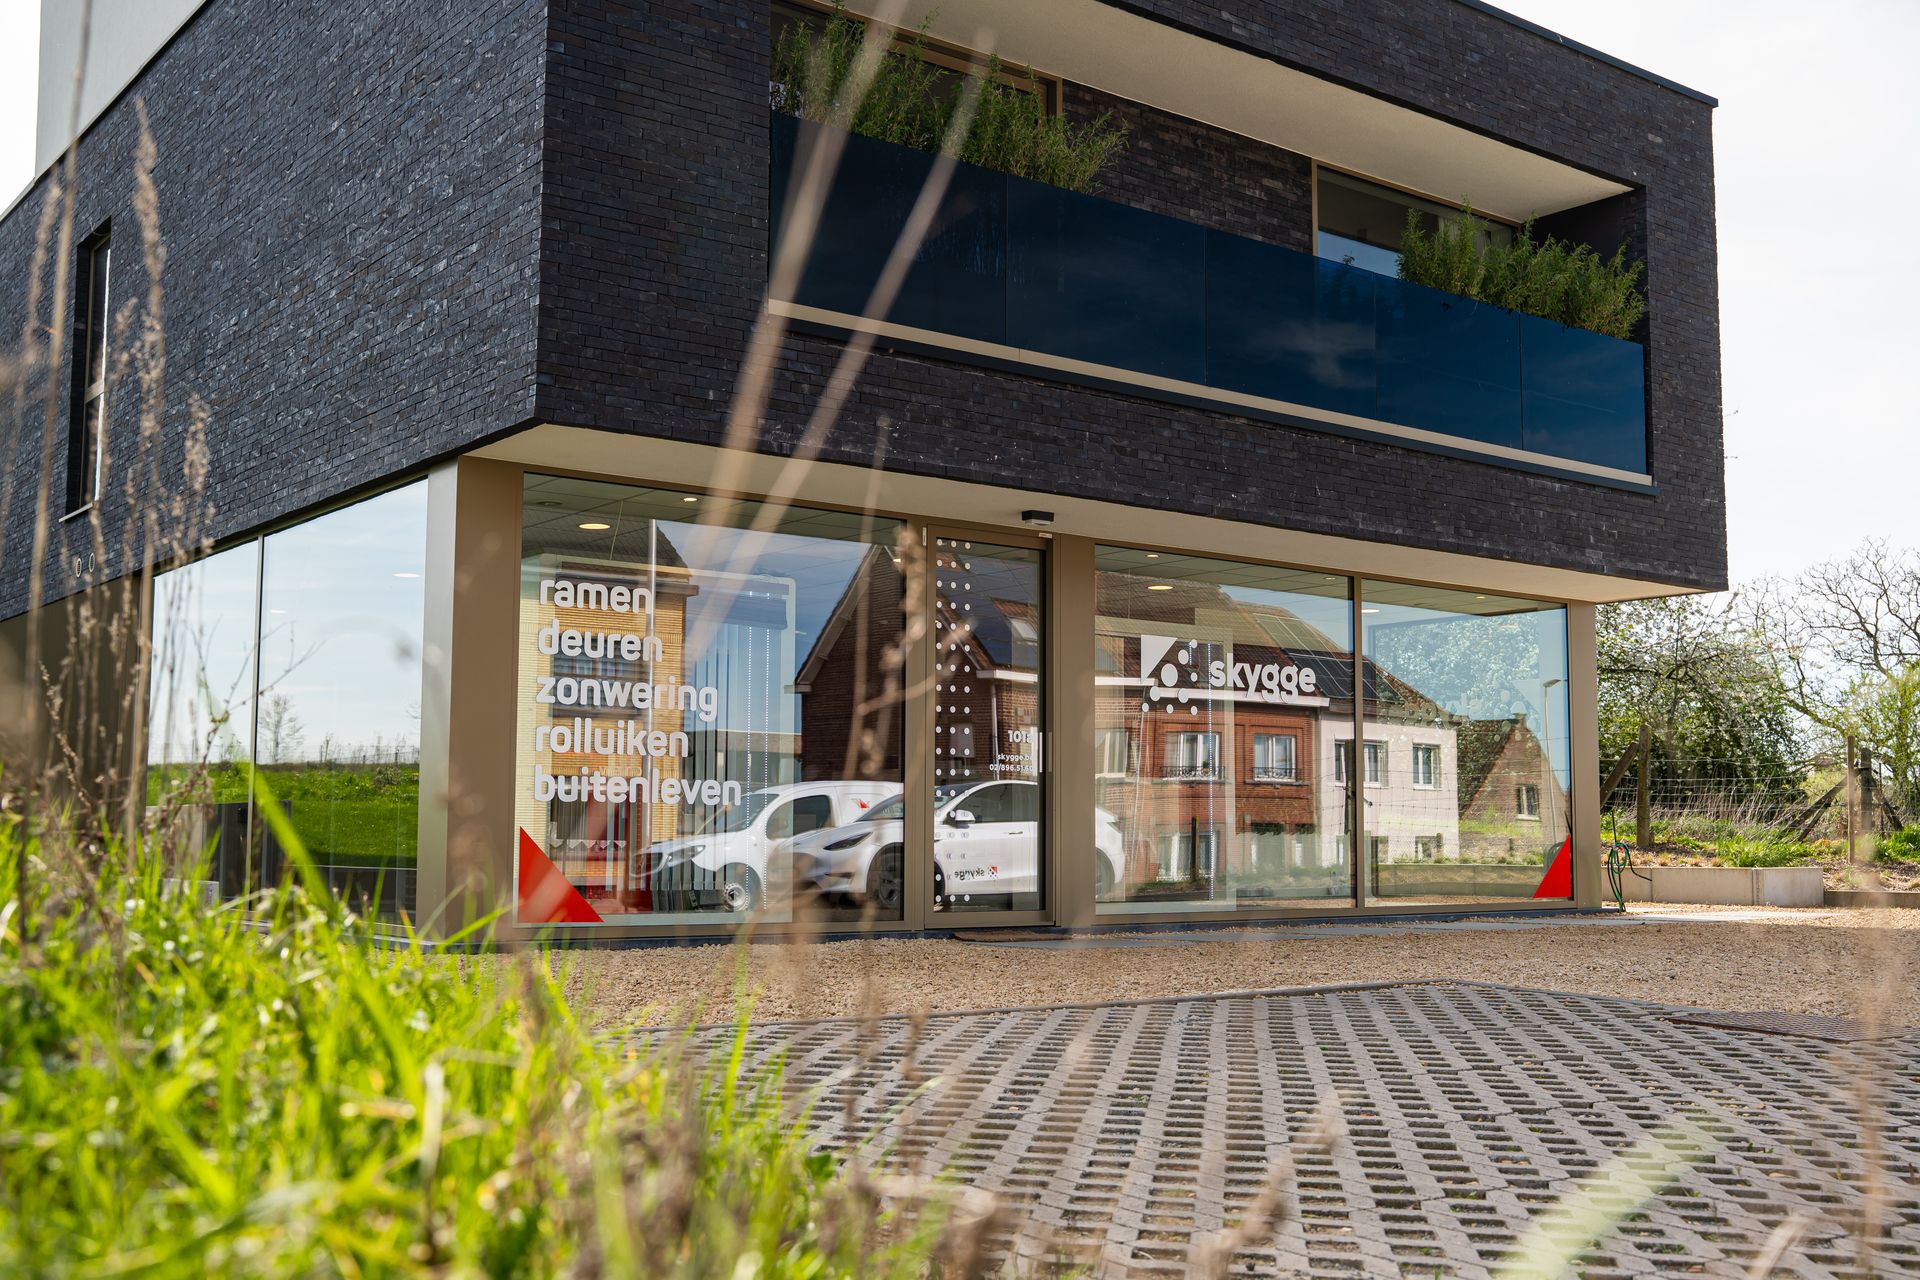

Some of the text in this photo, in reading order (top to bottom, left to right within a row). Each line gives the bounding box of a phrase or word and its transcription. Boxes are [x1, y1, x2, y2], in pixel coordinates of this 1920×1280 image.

[540, 580, 653, 613] ramen
[538, 619, 663, 662] deuren
[1210, 652, 1316, 704] skygge
[536, 677, 718, 722] zonwering
[535, 717, 689, 758] rolluiken
[534, 764, 742, 806] buitenleven
